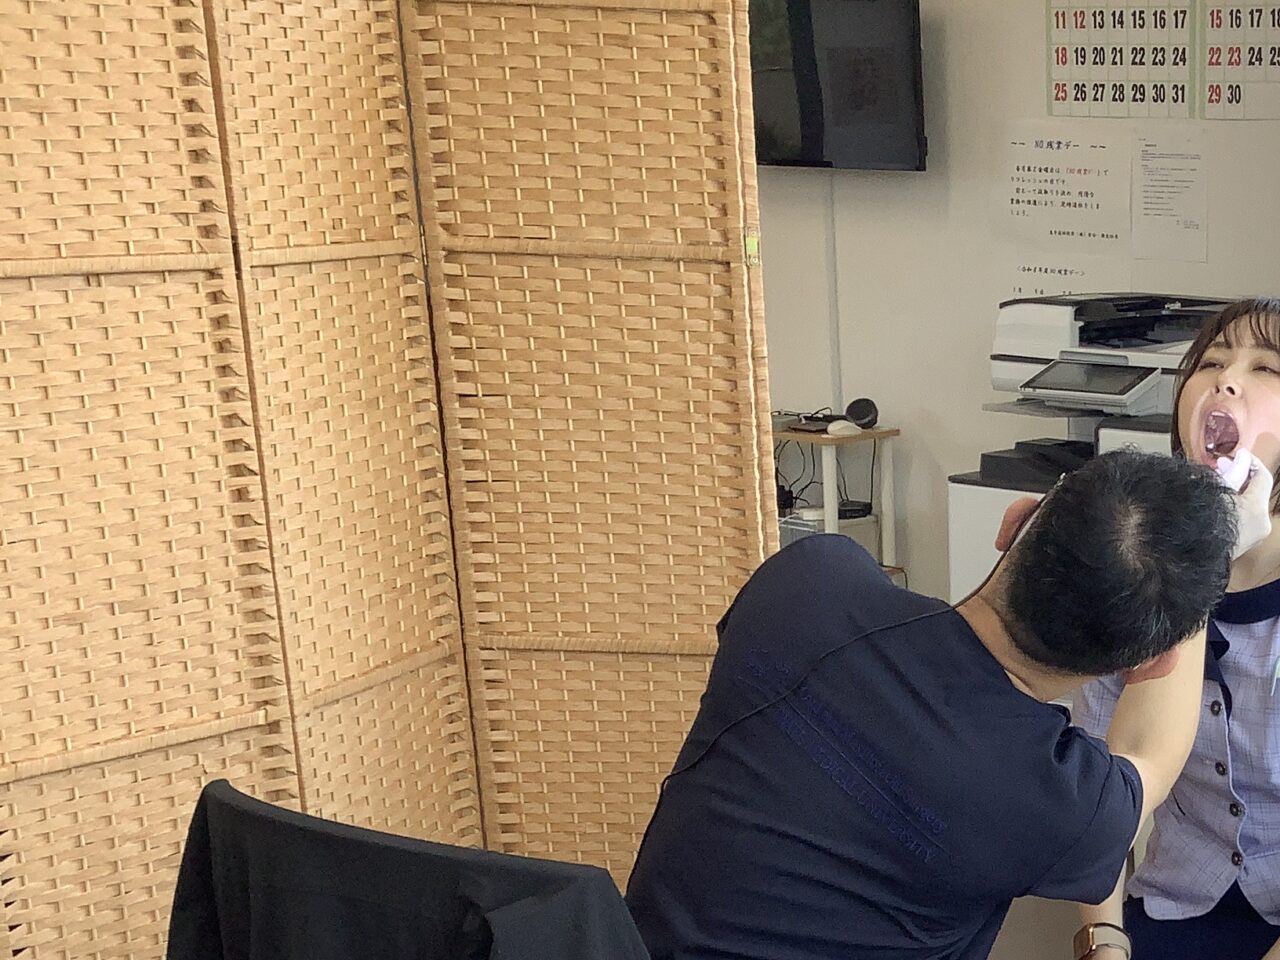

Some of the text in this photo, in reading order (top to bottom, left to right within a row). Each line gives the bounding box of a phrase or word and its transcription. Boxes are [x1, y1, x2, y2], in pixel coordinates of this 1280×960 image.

[1055, 10, 1186, 29] 11 12 13 14 15 16 17
[1210, 9, 1222, 28] 15
[1229, 9, 1241, 28] 16
[1249, 9, 1262, 28] 17
[1055, 47, 1186, 66] 18 19 20 21 22 23 24
[1208, 47, 1221, 66] 22
[1227, 47, 1241, 66] 23
[1248, 47, 1262, 66] 24
[1055, 83, 1185, 102] 25 26 27 28 29 30 31
[1208, 84, 1241, 104] 29 30
